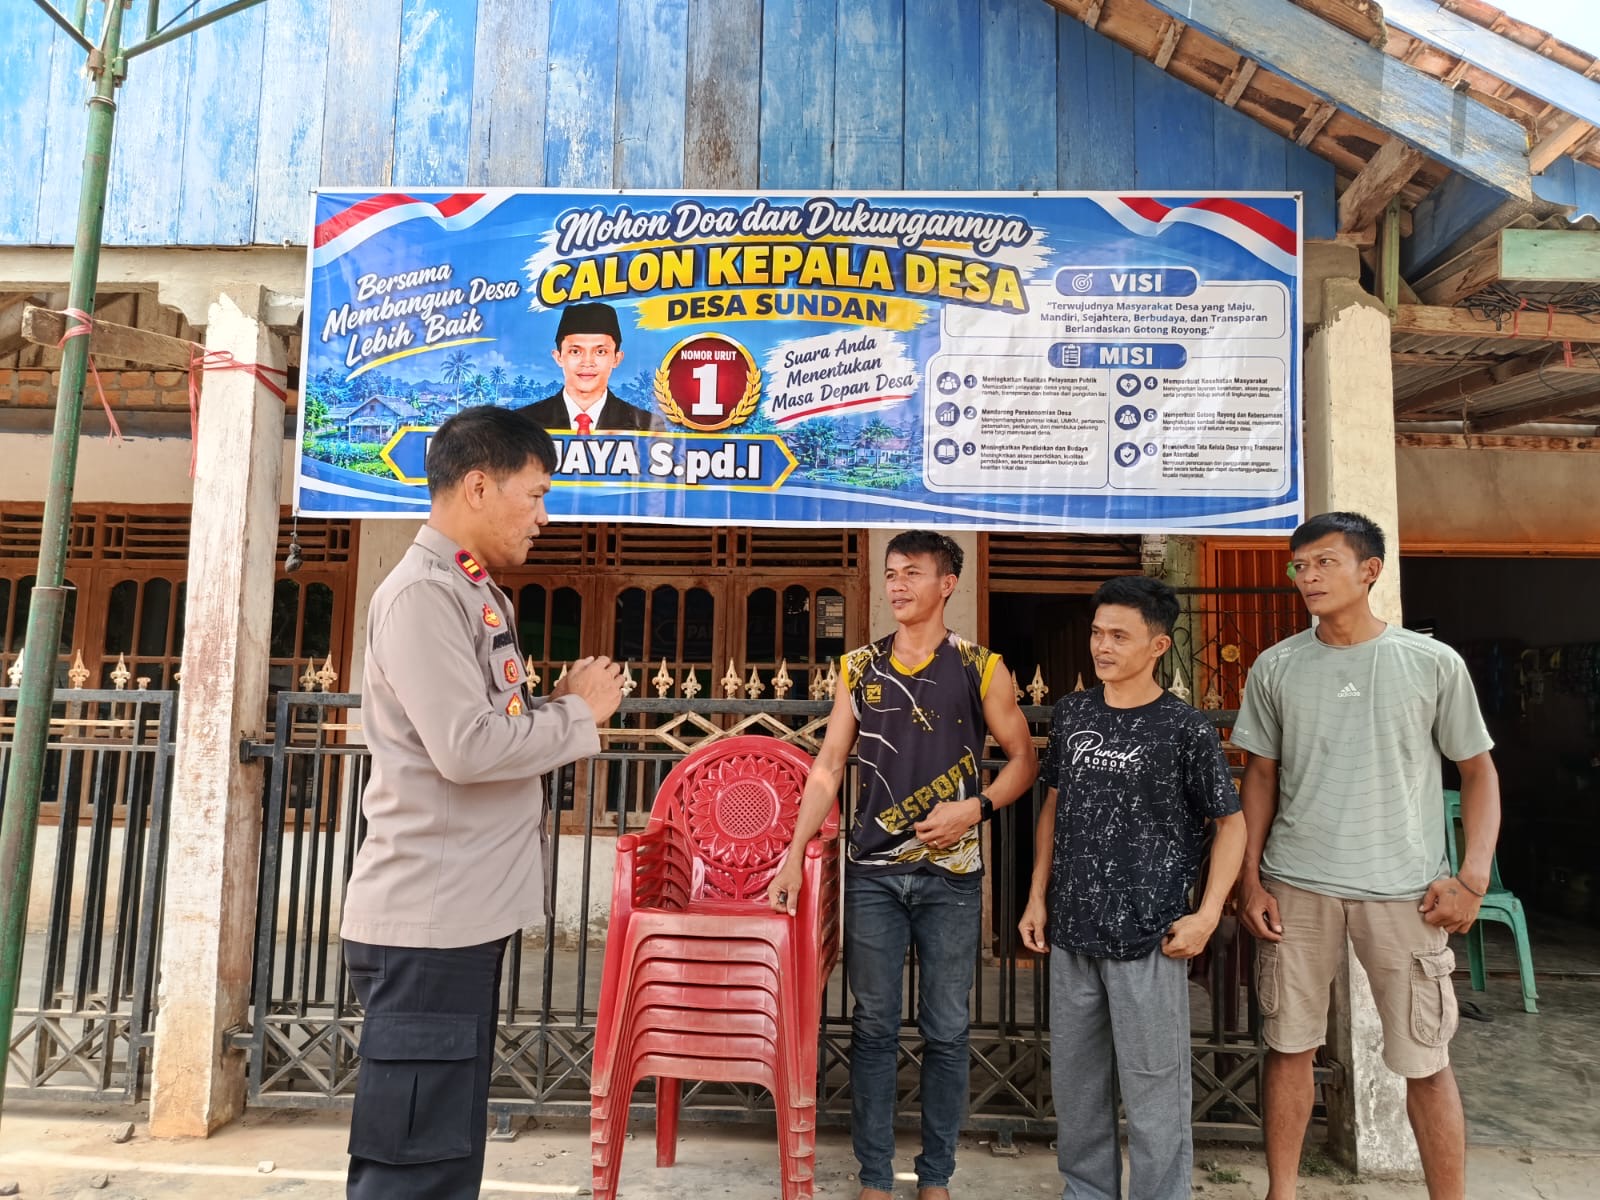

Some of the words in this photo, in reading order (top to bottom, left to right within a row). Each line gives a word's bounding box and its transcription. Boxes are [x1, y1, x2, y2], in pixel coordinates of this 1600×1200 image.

[560, 208, 671, 252] Mohon
[672, 202, 738, 239] Doa
[741, 201, 802, 233] dan
[806, 201, 1027, 252] Dukungannya
[356, 264, 452, 301] Bersama
[540, 247, 695, 305] CALON
[707, 245, 895, 292] KEPALA
[904, 252, 1025, 312] DESA
[1109, 273, 1162, 293] VISI
[321, 287, 465, 343] Membangun
[469, 278, 520, 305] Desa
[667, 294, 747, 322] DESA
[755, 293, 888, 323] SUNDAN
[1040, 313, 1080, 323] Mandiri,
[1082, 313, 1131, 324] Sejahtera,
[1133, 314, 1188, 325] Berbudaya,
[1190, 314, 1208, 323] dan
[1210, 314, 1268, 324] Transparan
[1116, 302, 1173, 312] Masyarakat
[1175, 303, 1199, 312] Desa
[1201, 304, 1225, 314] yang
[1227, 303, 1255, 313] Maju,
[344, 319, 415, 368] Lebih
[424, 308, 483, 344] Baik
[1065, 324, 1131, 334] Berlandaskan
[1133, 325, 1169, 335] Gotong
[681, 350, 712, 361] NOMOR
[714, 350, 737, 361] URUT
[783, 349, 830, 370] Suara
[834, 335, 877, 353] Anda
[1099, 347, 1153, 365] MISI
[786, 357, 882, 389] Menentukan
[1047, 376, 1078, 385] Pelayanan
[1233, 378, 1268, 386] Masyarakat
[691, 363, 724, 416] 1
[771, 391, 815, 412] Masa
[820, 380, 870, 403] Depan
[875, 372, 914, 392] Desa
[648, 441, 761, 485] S.pd.I
[1054, 444, 1065, 452] dan
[1067, 730, 1142, 766] Puncak
[1084, 755, 1126, 769] BOGOR
